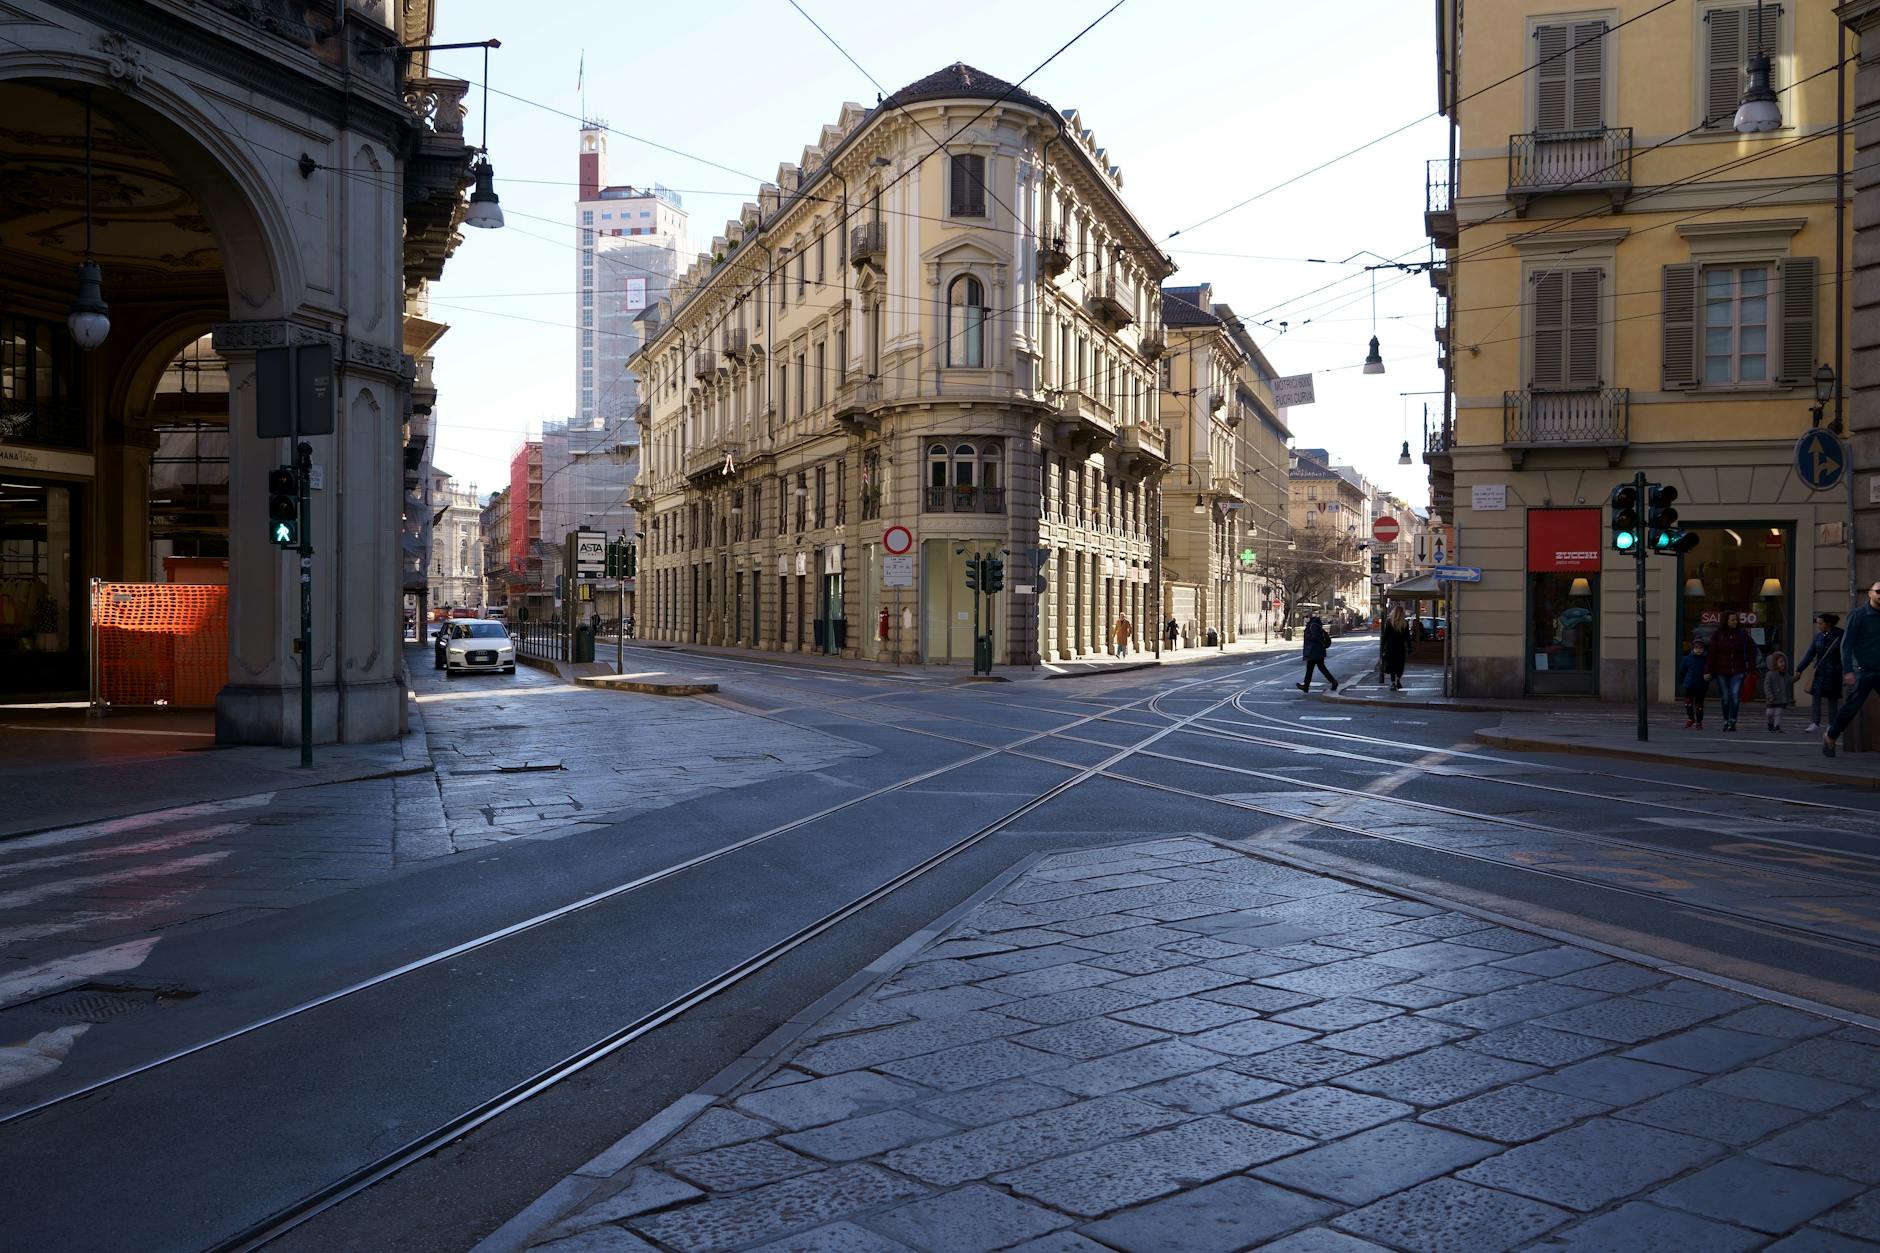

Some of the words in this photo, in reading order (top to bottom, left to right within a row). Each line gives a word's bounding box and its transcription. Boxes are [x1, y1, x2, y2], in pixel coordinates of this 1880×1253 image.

[1275, 393, 1293, 406] FUORI
[1293, 391, 1313, 404] CURVA
[580, 543, 603, 552] ASTA
[1555, 551, 1598, 560] ZUCCHI
